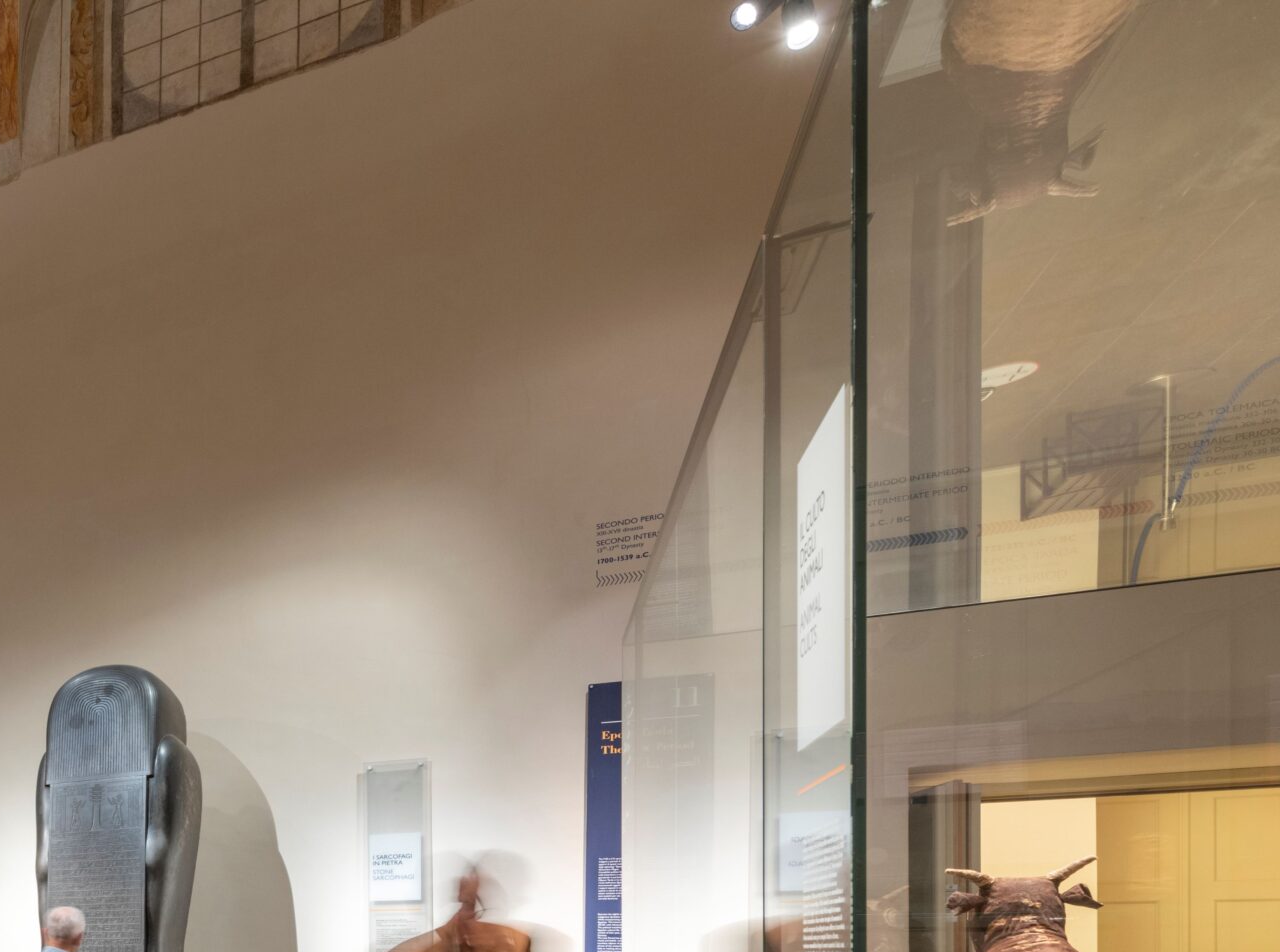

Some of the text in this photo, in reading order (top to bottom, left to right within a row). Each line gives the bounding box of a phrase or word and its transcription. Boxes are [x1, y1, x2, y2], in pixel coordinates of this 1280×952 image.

[867, 476, 907, 489] ERIODO
[595, 516, 639, 531] SECONDO
[595, 531, 660, 547] SECOND INTER
